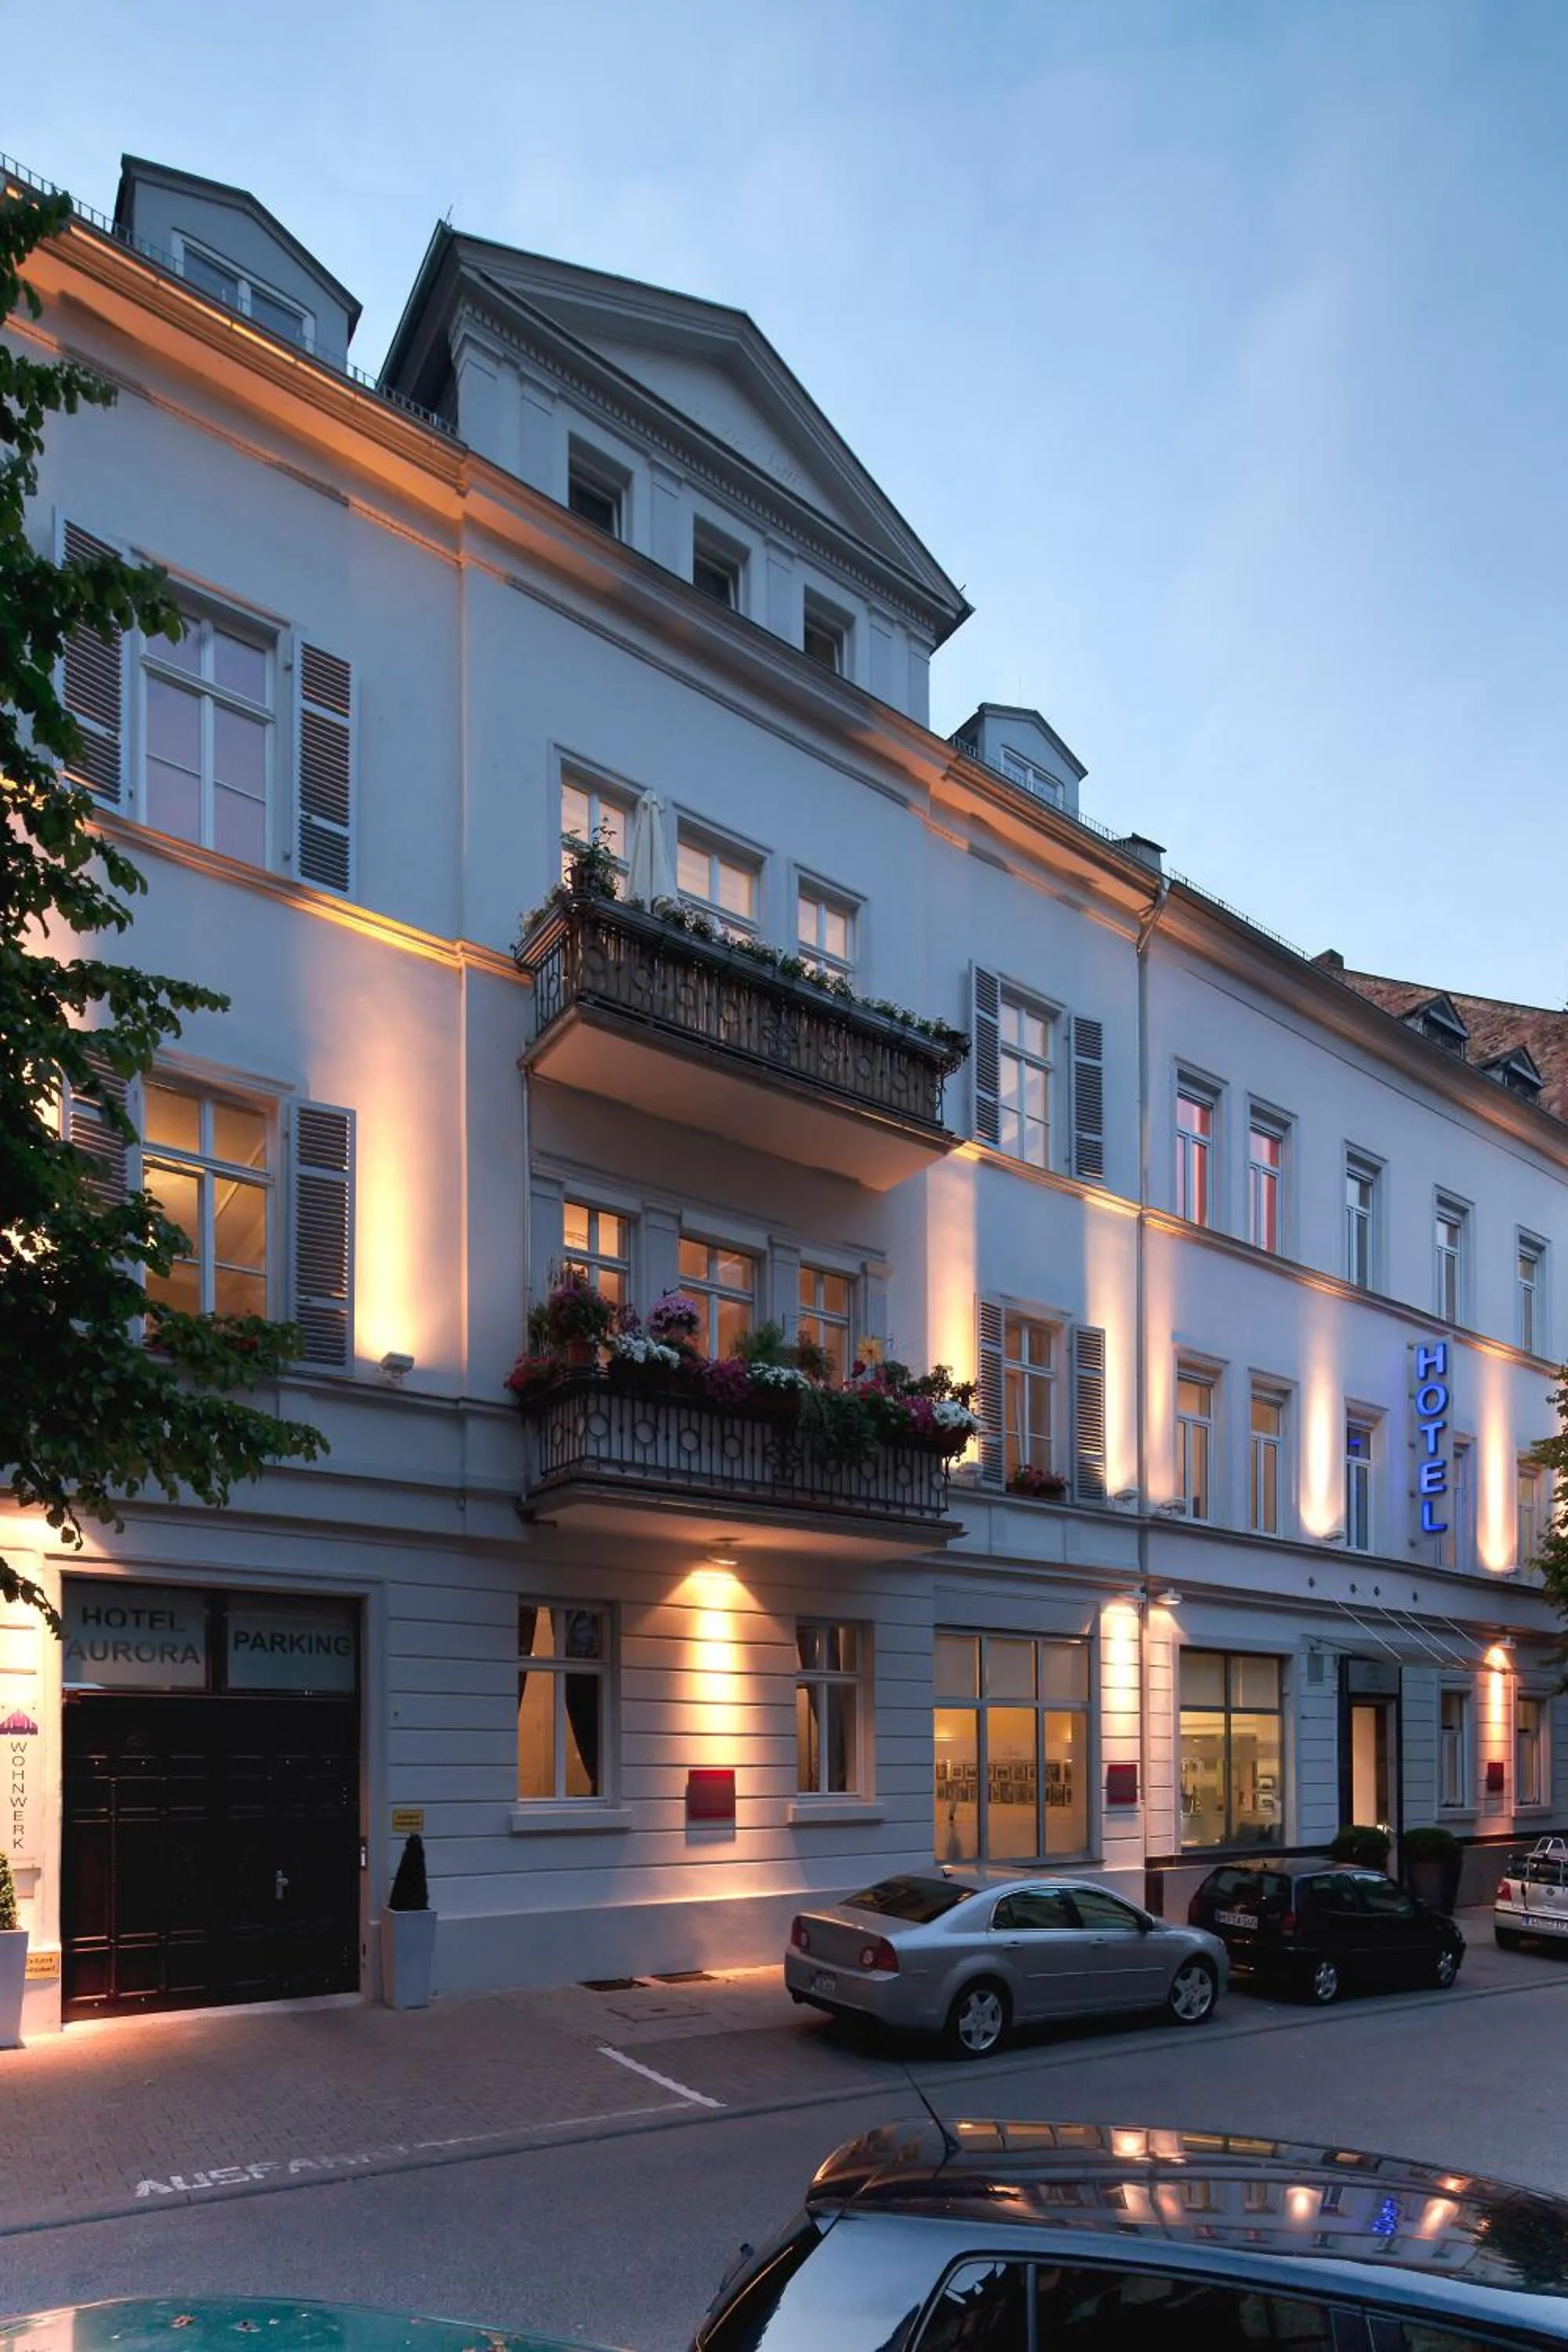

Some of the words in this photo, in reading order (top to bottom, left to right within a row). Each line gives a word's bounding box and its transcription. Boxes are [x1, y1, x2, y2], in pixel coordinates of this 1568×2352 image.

[1416, 1341, 1449, 1532] HOTEL
[81, 1606, 187, 1632] HOTEL
[65, 1639, 201, 1664] AURORA
[234, 1631, 352, 1657] PARKING
[10, 1741, 27, 1849] WOHNWERK
[135, 2145, 409, 2198] AUSFA
